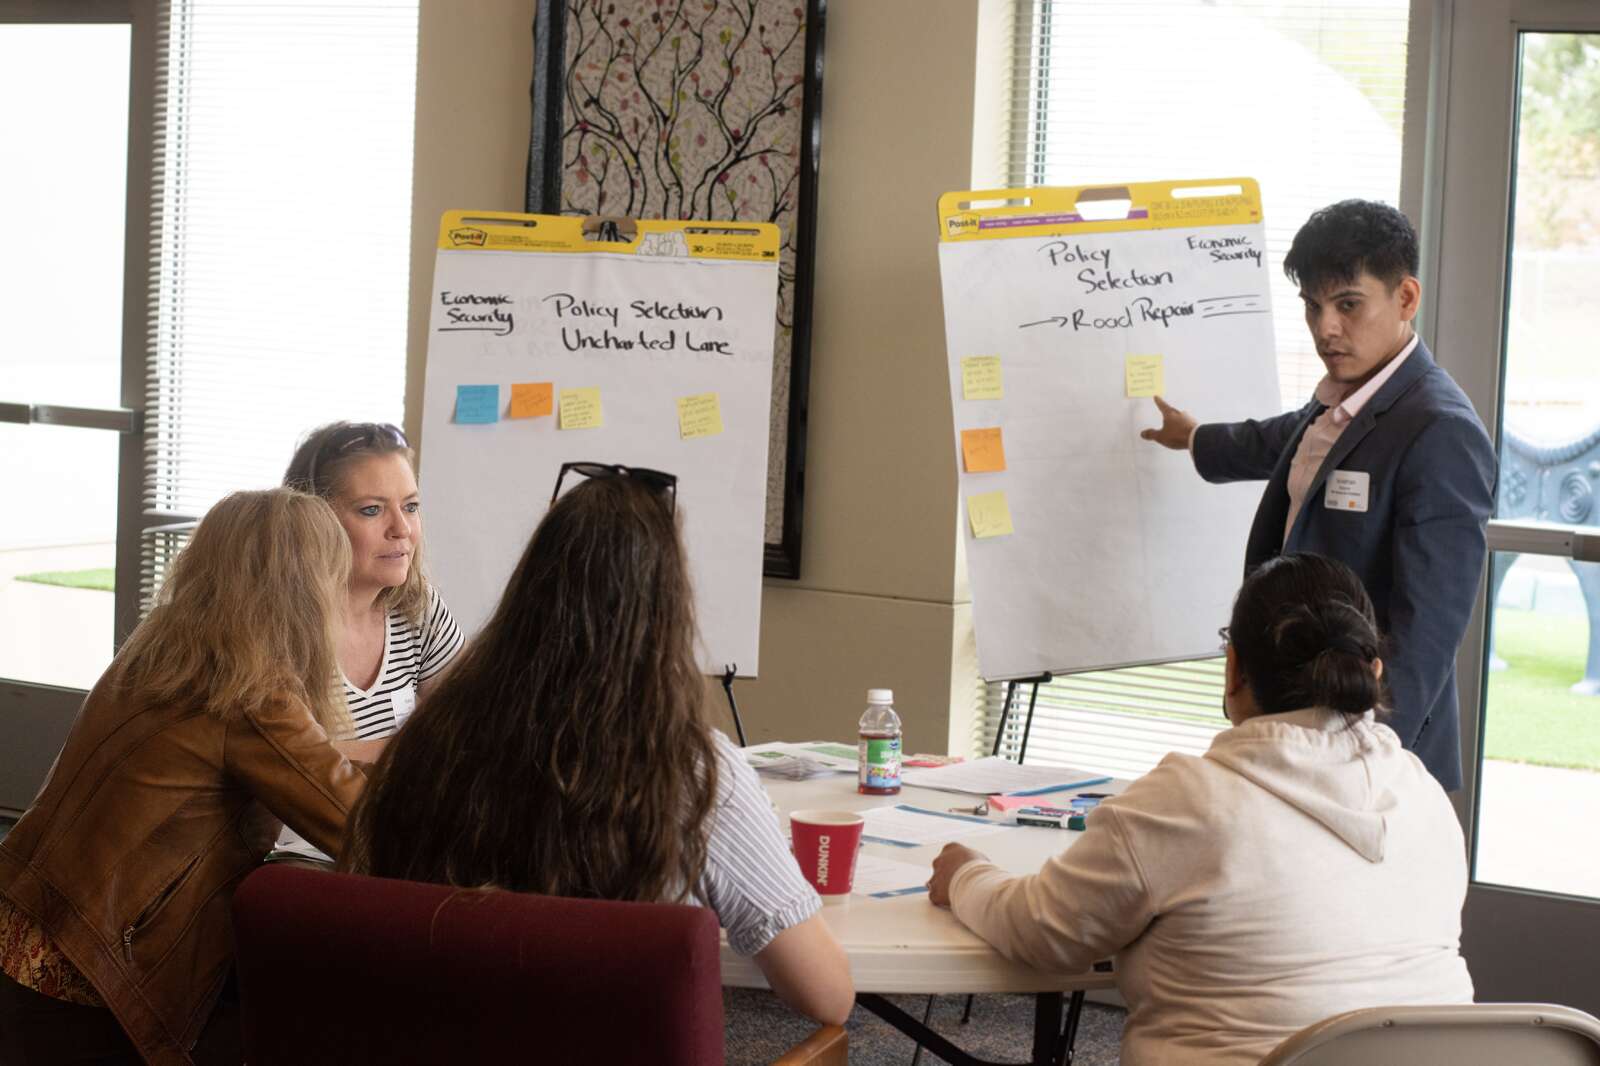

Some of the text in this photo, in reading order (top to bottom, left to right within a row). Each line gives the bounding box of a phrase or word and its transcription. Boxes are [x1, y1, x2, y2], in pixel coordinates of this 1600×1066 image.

[454, 232, 483, 242] Post-it
[949, 219, 977, 228] Post-it
[1038, 241, 1111, 269] Policy
[1186, 234, 1252, 250] Economic
[1209, 247, 1262, 268] Security
[1077, 268, 1174, 295] Selection
[440, 291, 514, 306] Economic
[541, 293, 724, 328] Policy Selection
[446, 307, 515, 337] Security
[1072, 296, 1195, 332] Road Repair
[561, 326, 735, 356] Uncharted Lane
